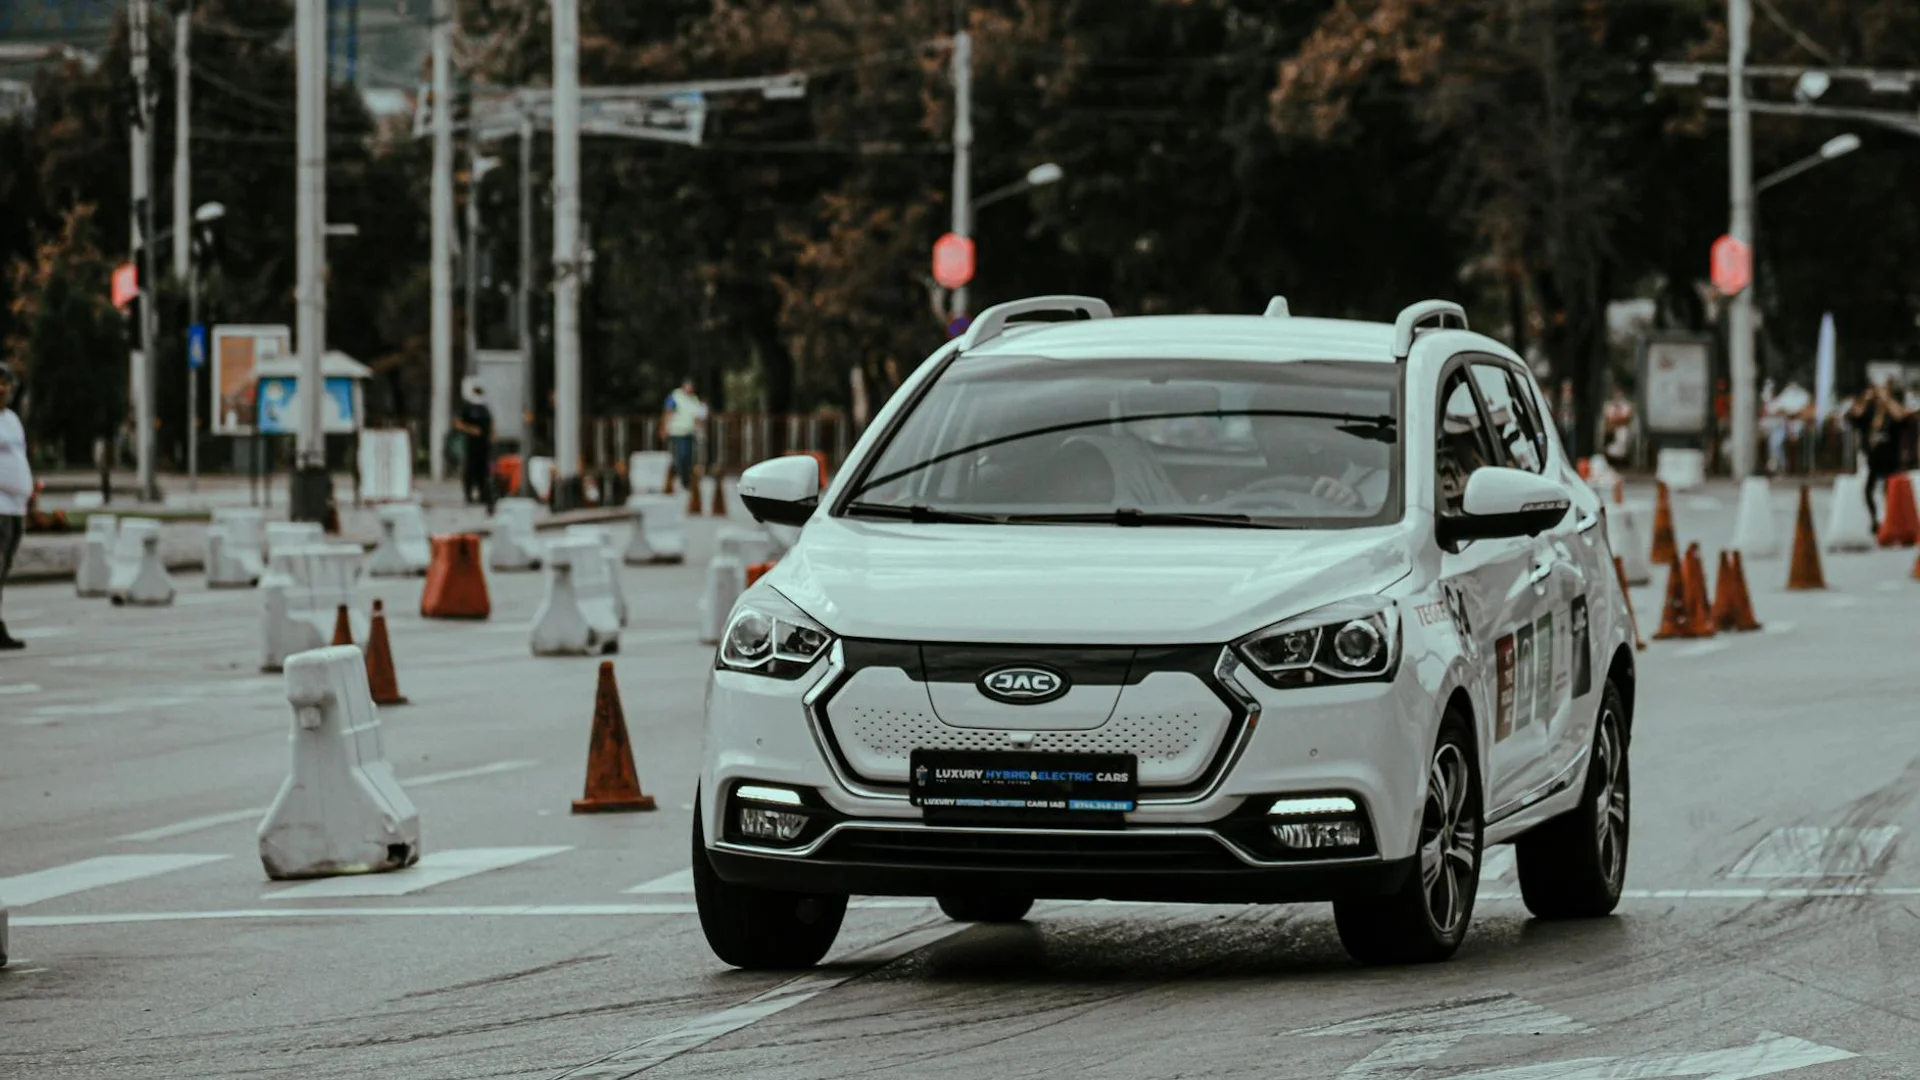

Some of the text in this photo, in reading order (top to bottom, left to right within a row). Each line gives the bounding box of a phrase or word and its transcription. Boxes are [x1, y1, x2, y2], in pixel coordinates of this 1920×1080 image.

[995, 674, 1049, 690] JAC
[935, 768, 1129, 783] LUXURY HYBRID&ELECTRIC CARS
[923, 798, 955, 806] LUXURY
